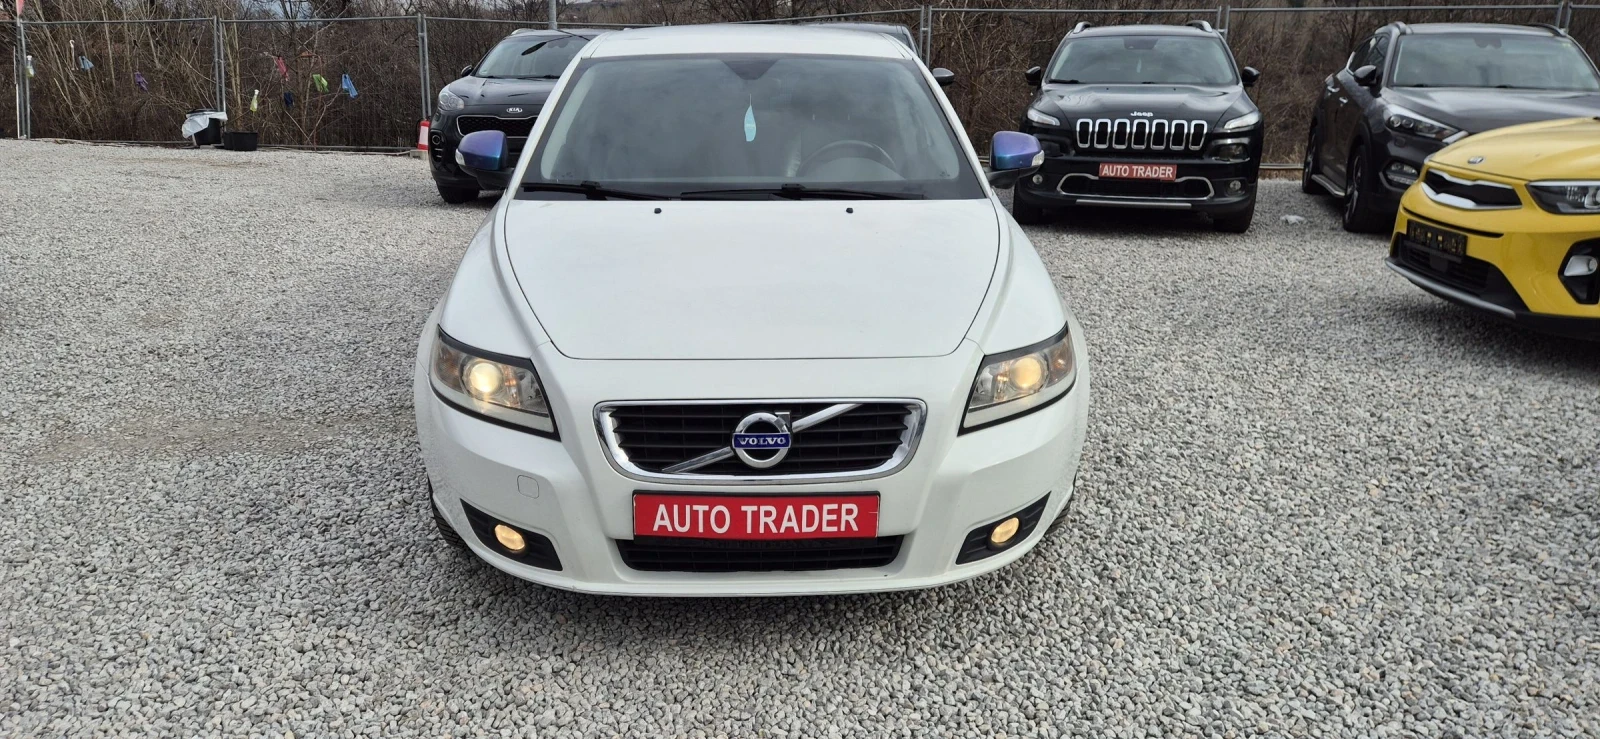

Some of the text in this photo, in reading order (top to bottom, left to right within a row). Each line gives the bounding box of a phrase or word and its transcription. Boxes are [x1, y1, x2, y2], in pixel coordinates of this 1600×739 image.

[1102, 165, 1173, 178] AUTO TRADER
[737, 436, 786, 445] VOLVO
[653, 503, 859, 534] AUTO TRADER
